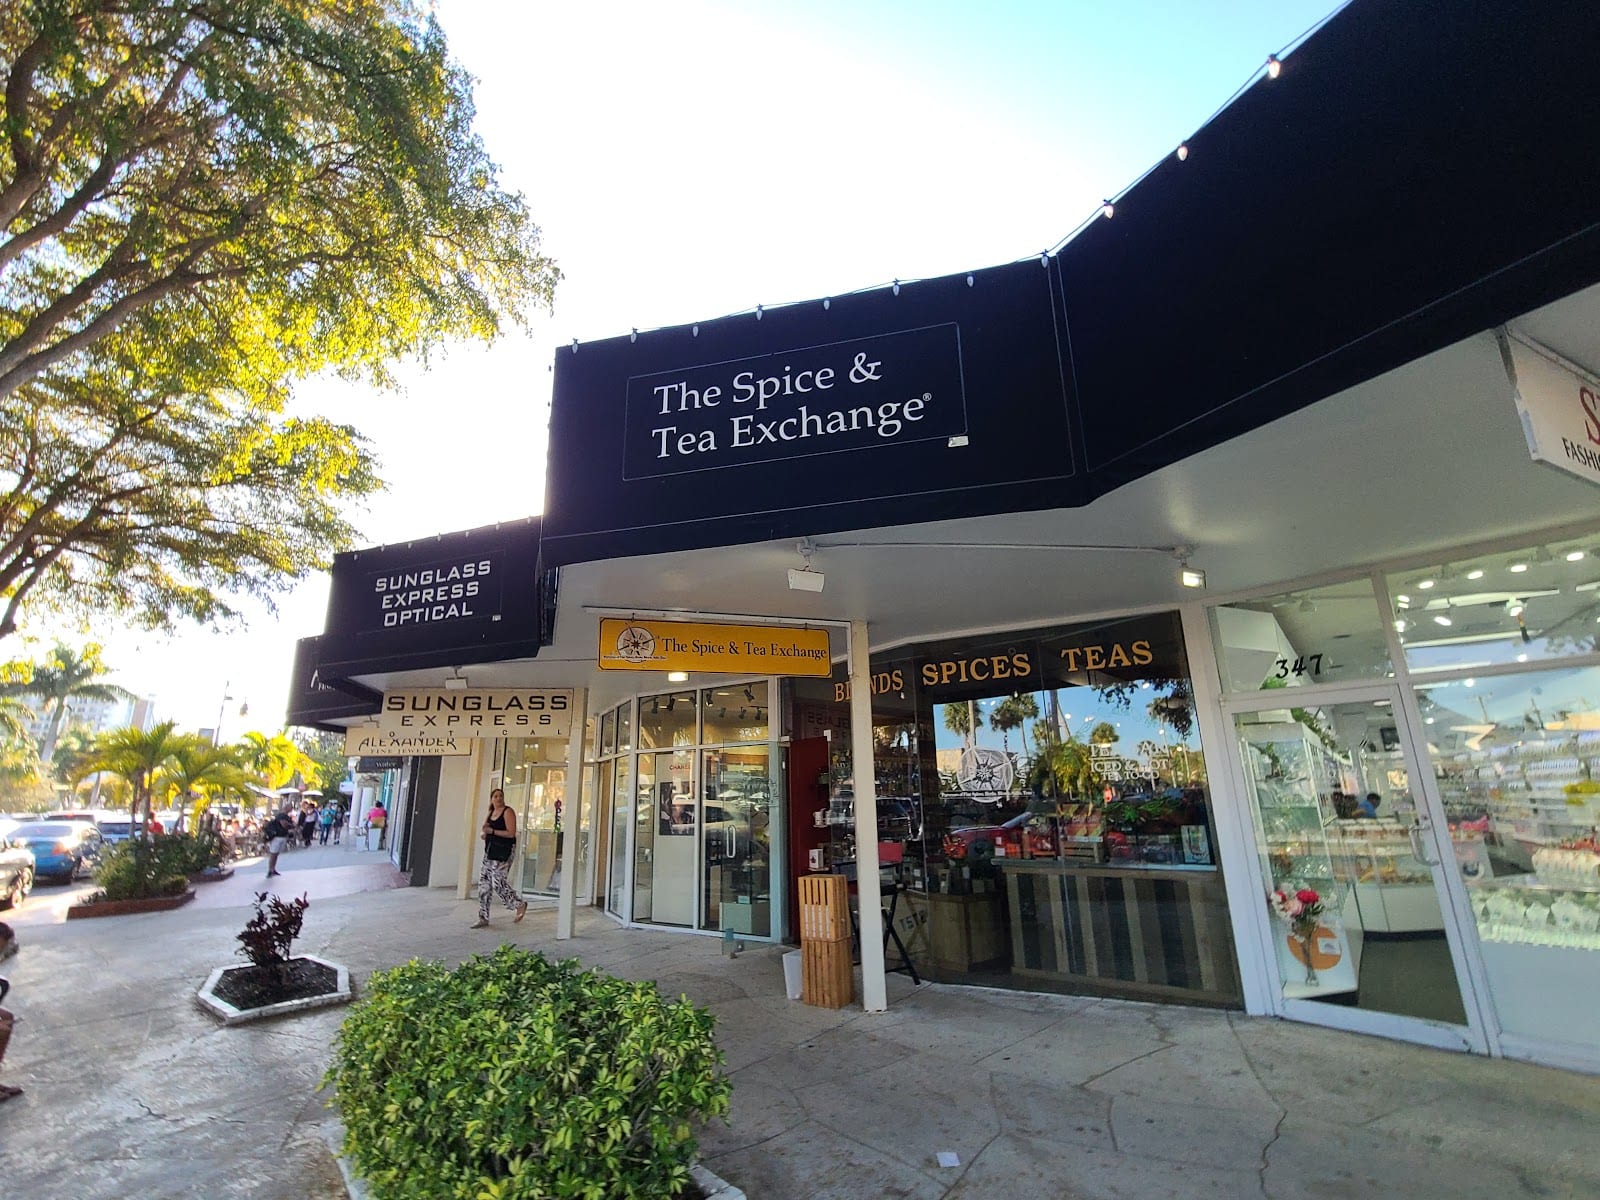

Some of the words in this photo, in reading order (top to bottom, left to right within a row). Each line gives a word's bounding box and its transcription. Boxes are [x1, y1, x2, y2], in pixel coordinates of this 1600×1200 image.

[653, 381, 722, 415] The
[732, 365, 836, 410] Spice
[849, 352, 883, 385] &
[1580, 386, 1600, 446] S
[651, 426, 718, 459] Tea
[1561, 436, 1600, 473] FASHI
[375, 560, 491, 592] SUNGLASS
[381, 581, 480, 609] EXPRESS
[384, 602, 473, 627] OPTICAL
[661, 638, 688, 653] The
[692, 639, 725, 656] Spice
[728, 641, 740, 655] &
[743, 641, 766, 656] Tea
[770, 643, 827, 661] Exchange
[1060, 640, 1153, 673] TEAS
[922, 653, 1032, 686] SPICES
[1275, 653, 1323, 679] 347
[386, 695, 568, 711] SUNGLASS
[389, 729, 563, 738] OPTICAL
[401, 715, 552, 727] EXPRESS
[359, 738, 457, 751] ALEXANDER
[1090, 760, 1122, 773] ICED
